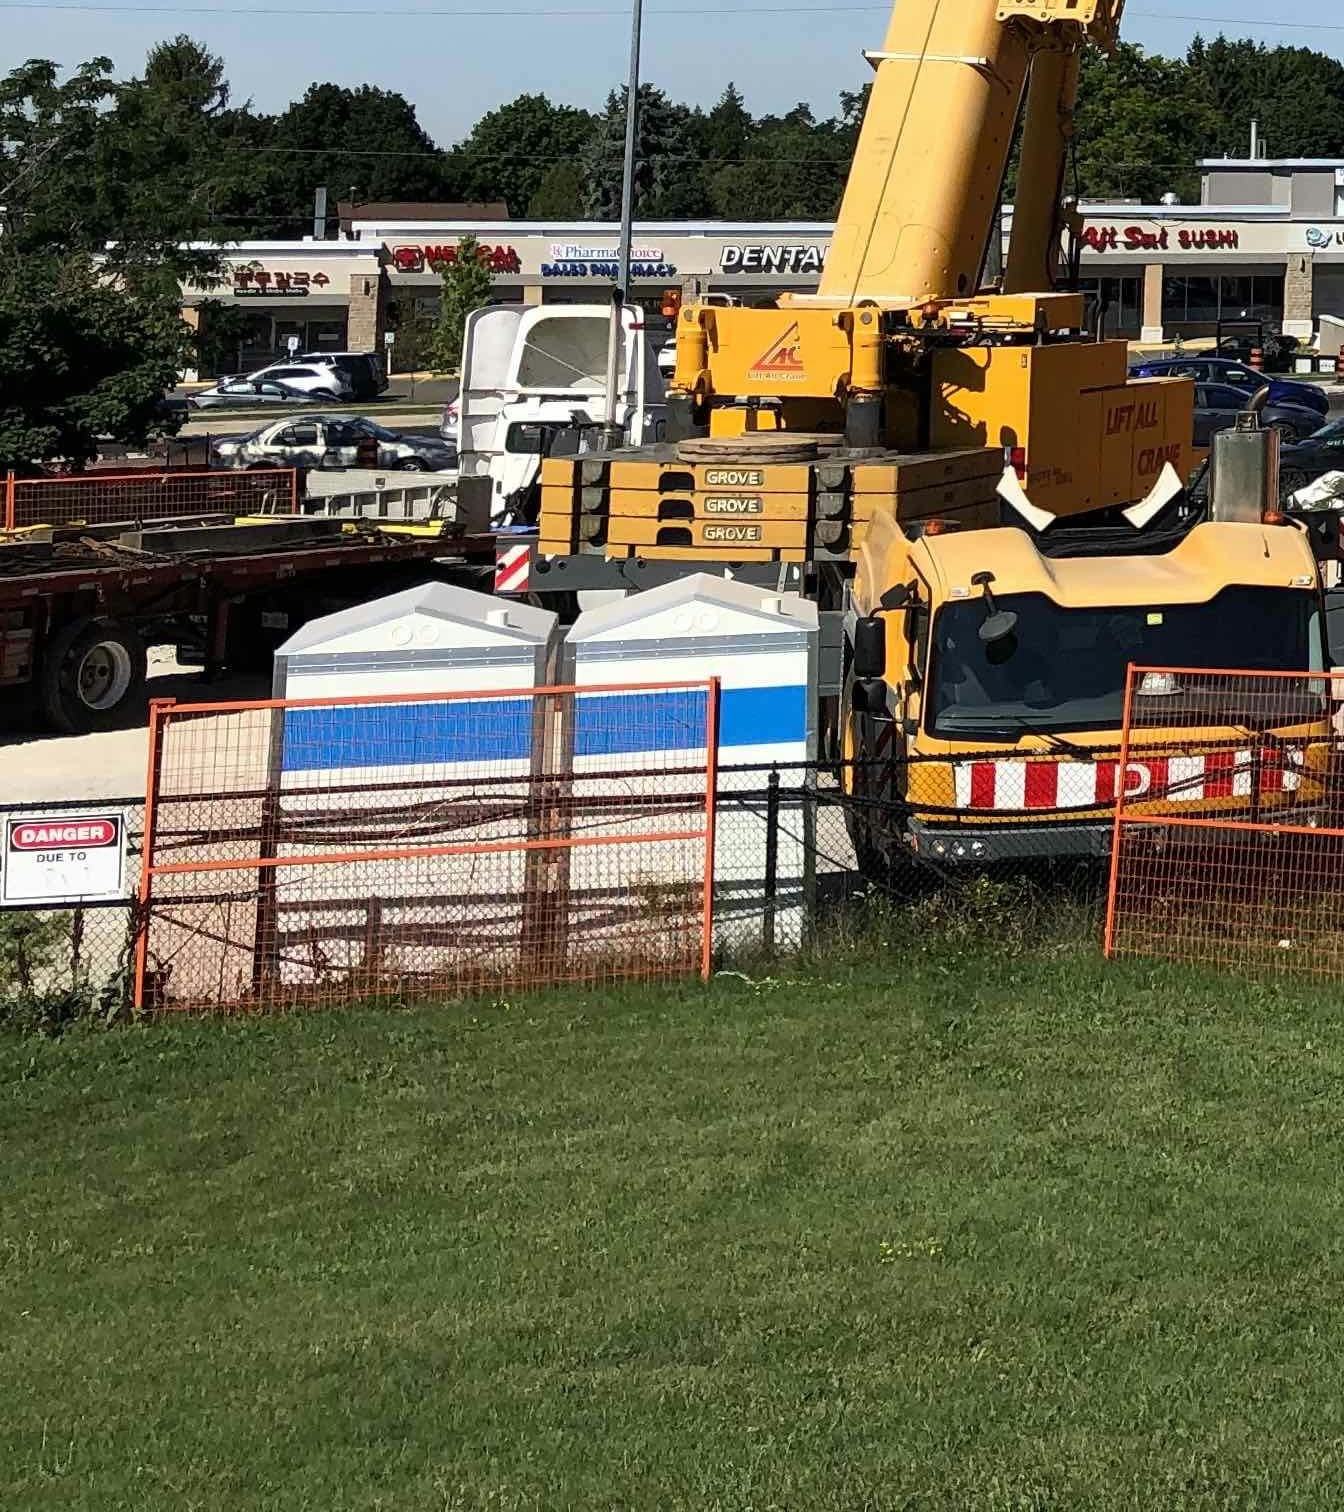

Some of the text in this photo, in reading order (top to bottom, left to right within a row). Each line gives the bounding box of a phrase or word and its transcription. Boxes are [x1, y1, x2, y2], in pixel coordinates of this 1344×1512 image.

[1178, 230, 1239, 249] SUSHI
[590, 263, 677, 277] PHAMACY
[1105, 401, 1159, 435] LIFT ALL
[706, 471, 759, 485] GROVE
[706, 499, 758, 513] GROVE
[705, 527, 757, 541] GROVE
[21, 826, 104, 843] DANGER
[36, 852, 87, 863] DUE TO
